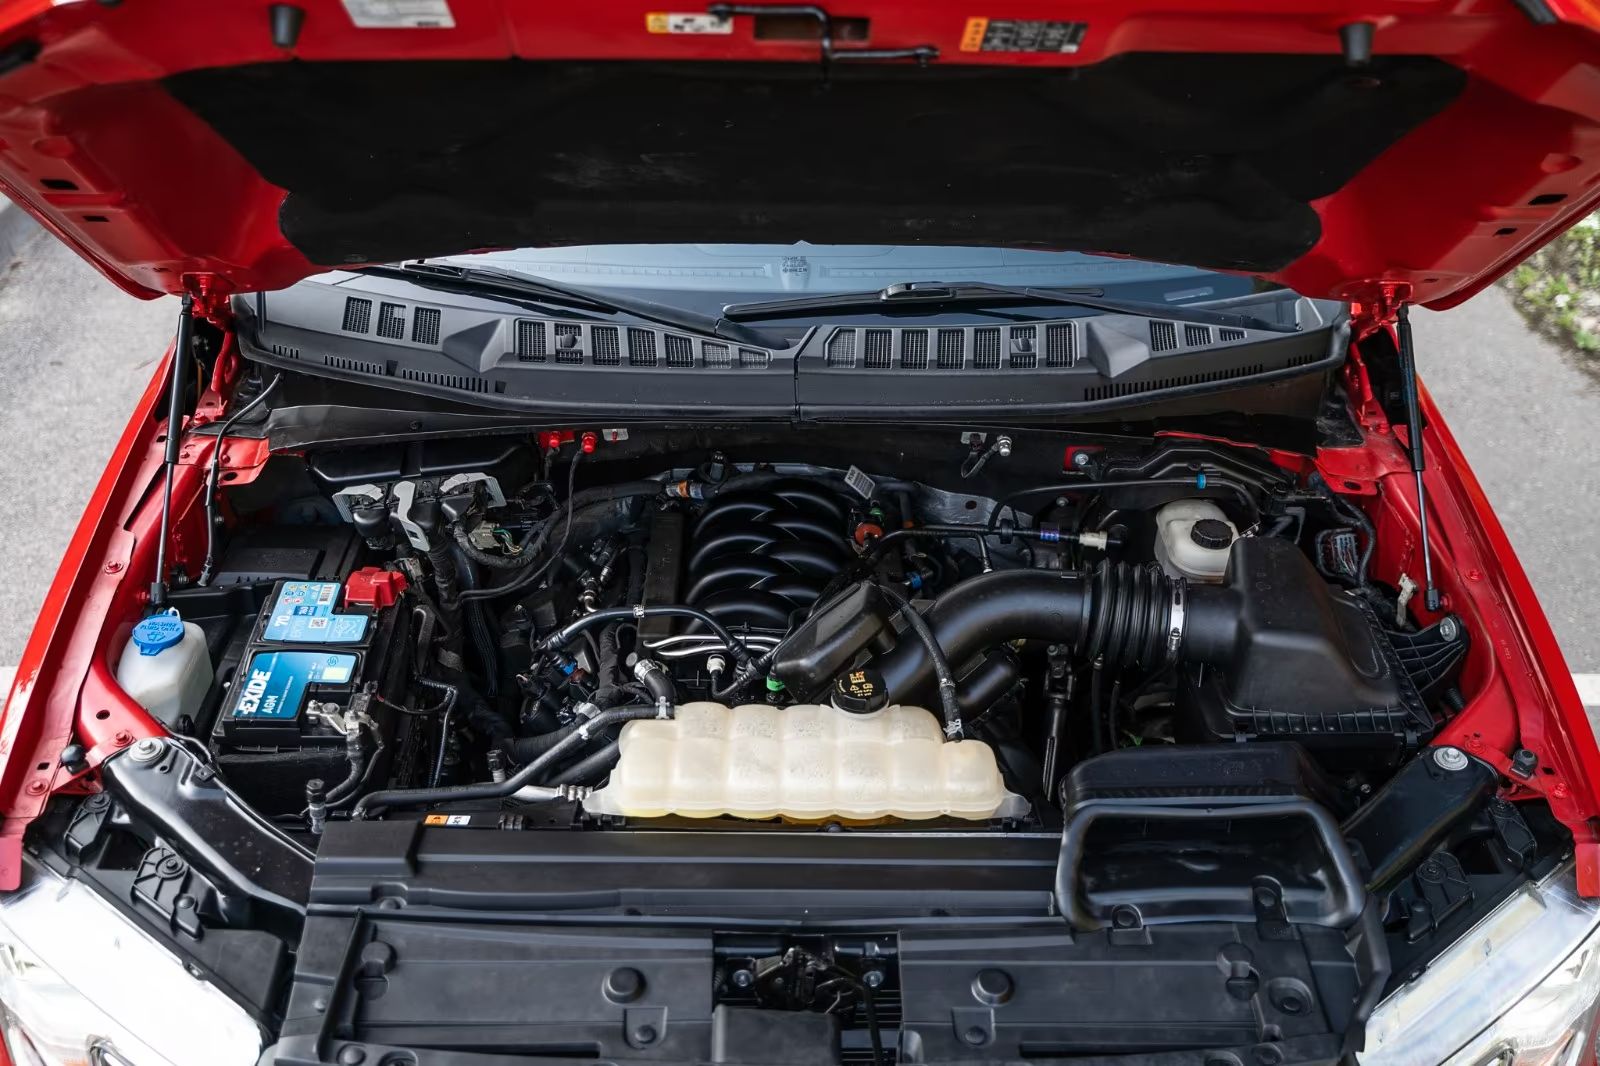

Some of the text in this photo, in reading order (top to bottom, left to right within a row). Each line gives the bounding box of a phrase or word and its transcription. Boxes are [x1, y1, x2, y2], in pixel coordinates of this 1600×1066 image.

[275, 615, 290, 627] 70
[238, 668, 272, 714] EXIDE
[261, 695, 279, 714] AGM
